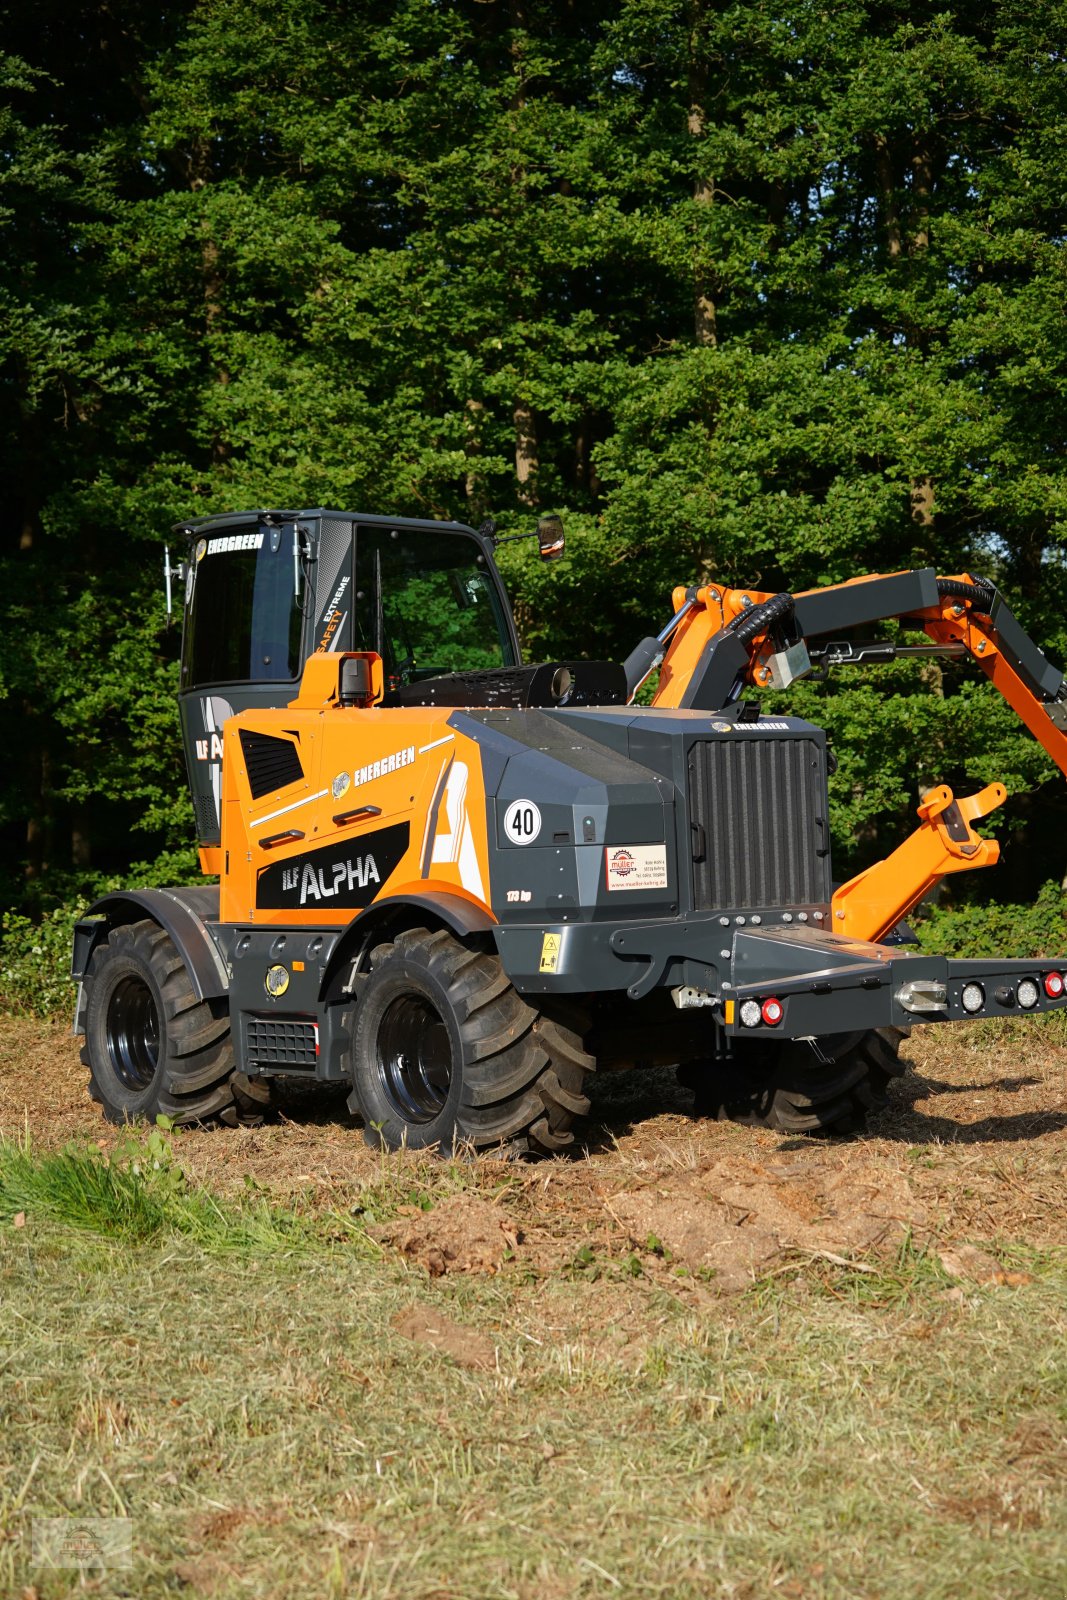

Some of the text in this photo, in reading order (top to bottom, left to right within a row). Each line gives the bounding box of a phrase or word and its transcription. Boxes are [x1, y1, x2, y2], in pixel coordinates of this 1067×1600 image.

[207, 533, 265, 555] ENERGREEN
[323, 576, 351, 623] EXTREME
[316, 609, 343, 654] SAFETY
[732, 722, 790, 731] ENERGREEN
[354, 745, 415, 788] ENERGREEN
[512, 808, 534, 836] 40
[282, 853, 381, 905] ILF ALPHA
[506, 890, 532, 902] 173 hp
